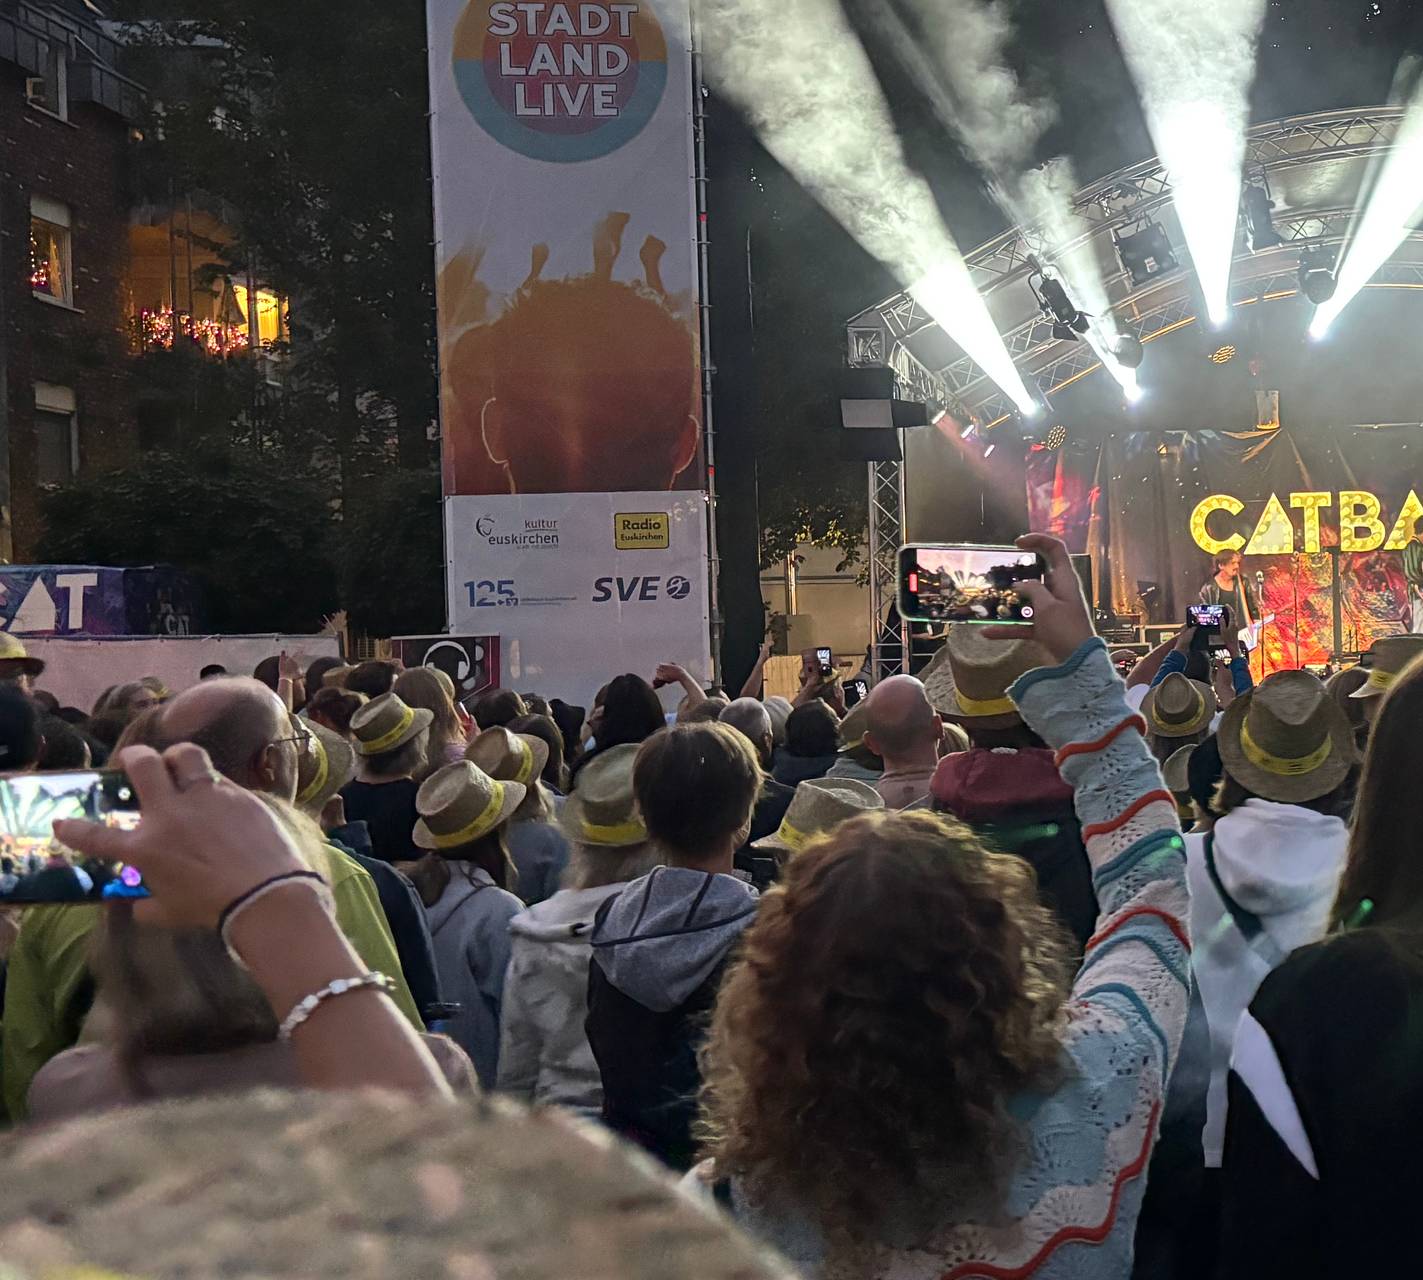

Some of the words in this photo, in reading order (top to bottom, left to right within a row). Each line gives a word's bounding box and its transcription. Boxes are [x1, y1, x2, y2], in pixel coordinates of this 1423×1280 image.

[487, 3, 639, 37] STADT
[500, 42, 630, 76] LAND
[515, 82, 619, 116] LIVE
[488, 532, 559, 545] euskirchen
[524, 519, 558, 529] kultur
[622, 518, 661, 530] Radio
[0, 572, 98, 633] AT
[592, 576, 660, 602] SVE
